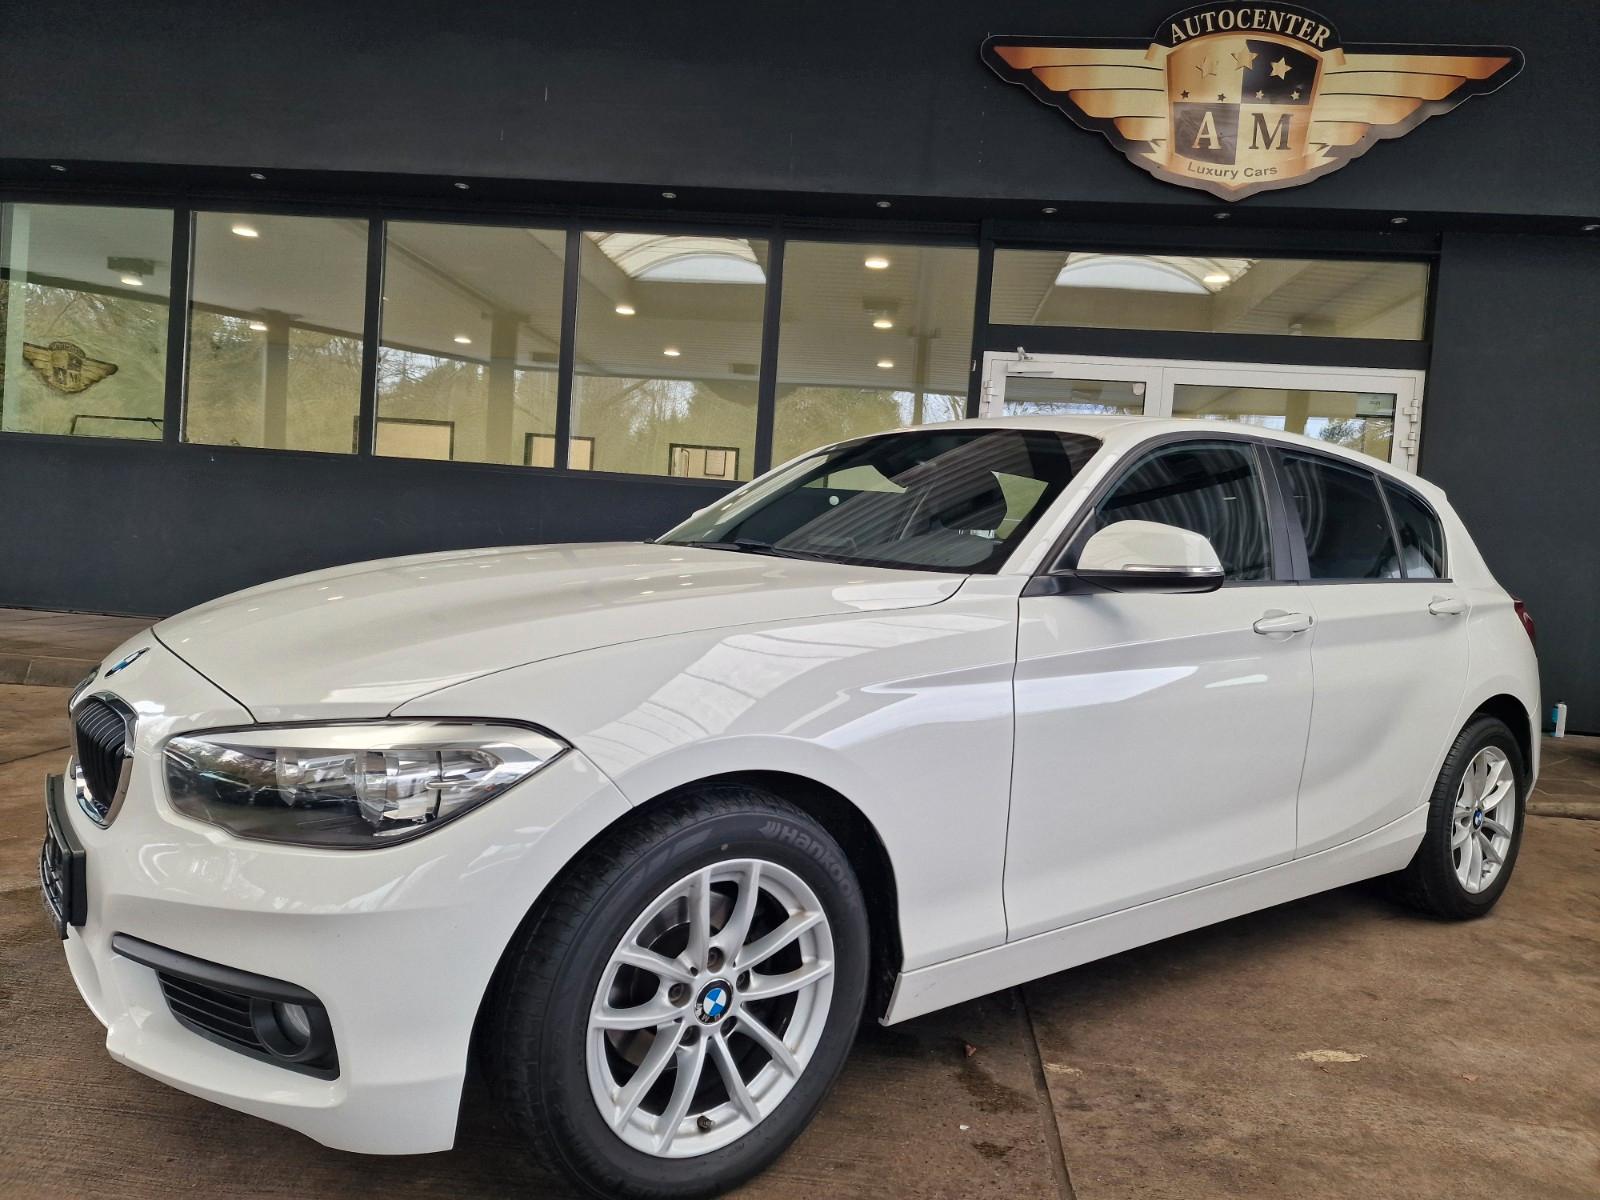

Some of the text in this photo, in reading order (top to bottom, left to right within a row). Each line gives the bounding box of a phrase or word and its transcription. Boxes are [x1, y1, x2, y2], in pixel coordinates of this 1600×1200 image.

[1171, 8, 1331, 48] AUTOCENTER
[1192, 111, 1294, 151] A M
[1187, 161, 1278, 180] Luxury Cars
